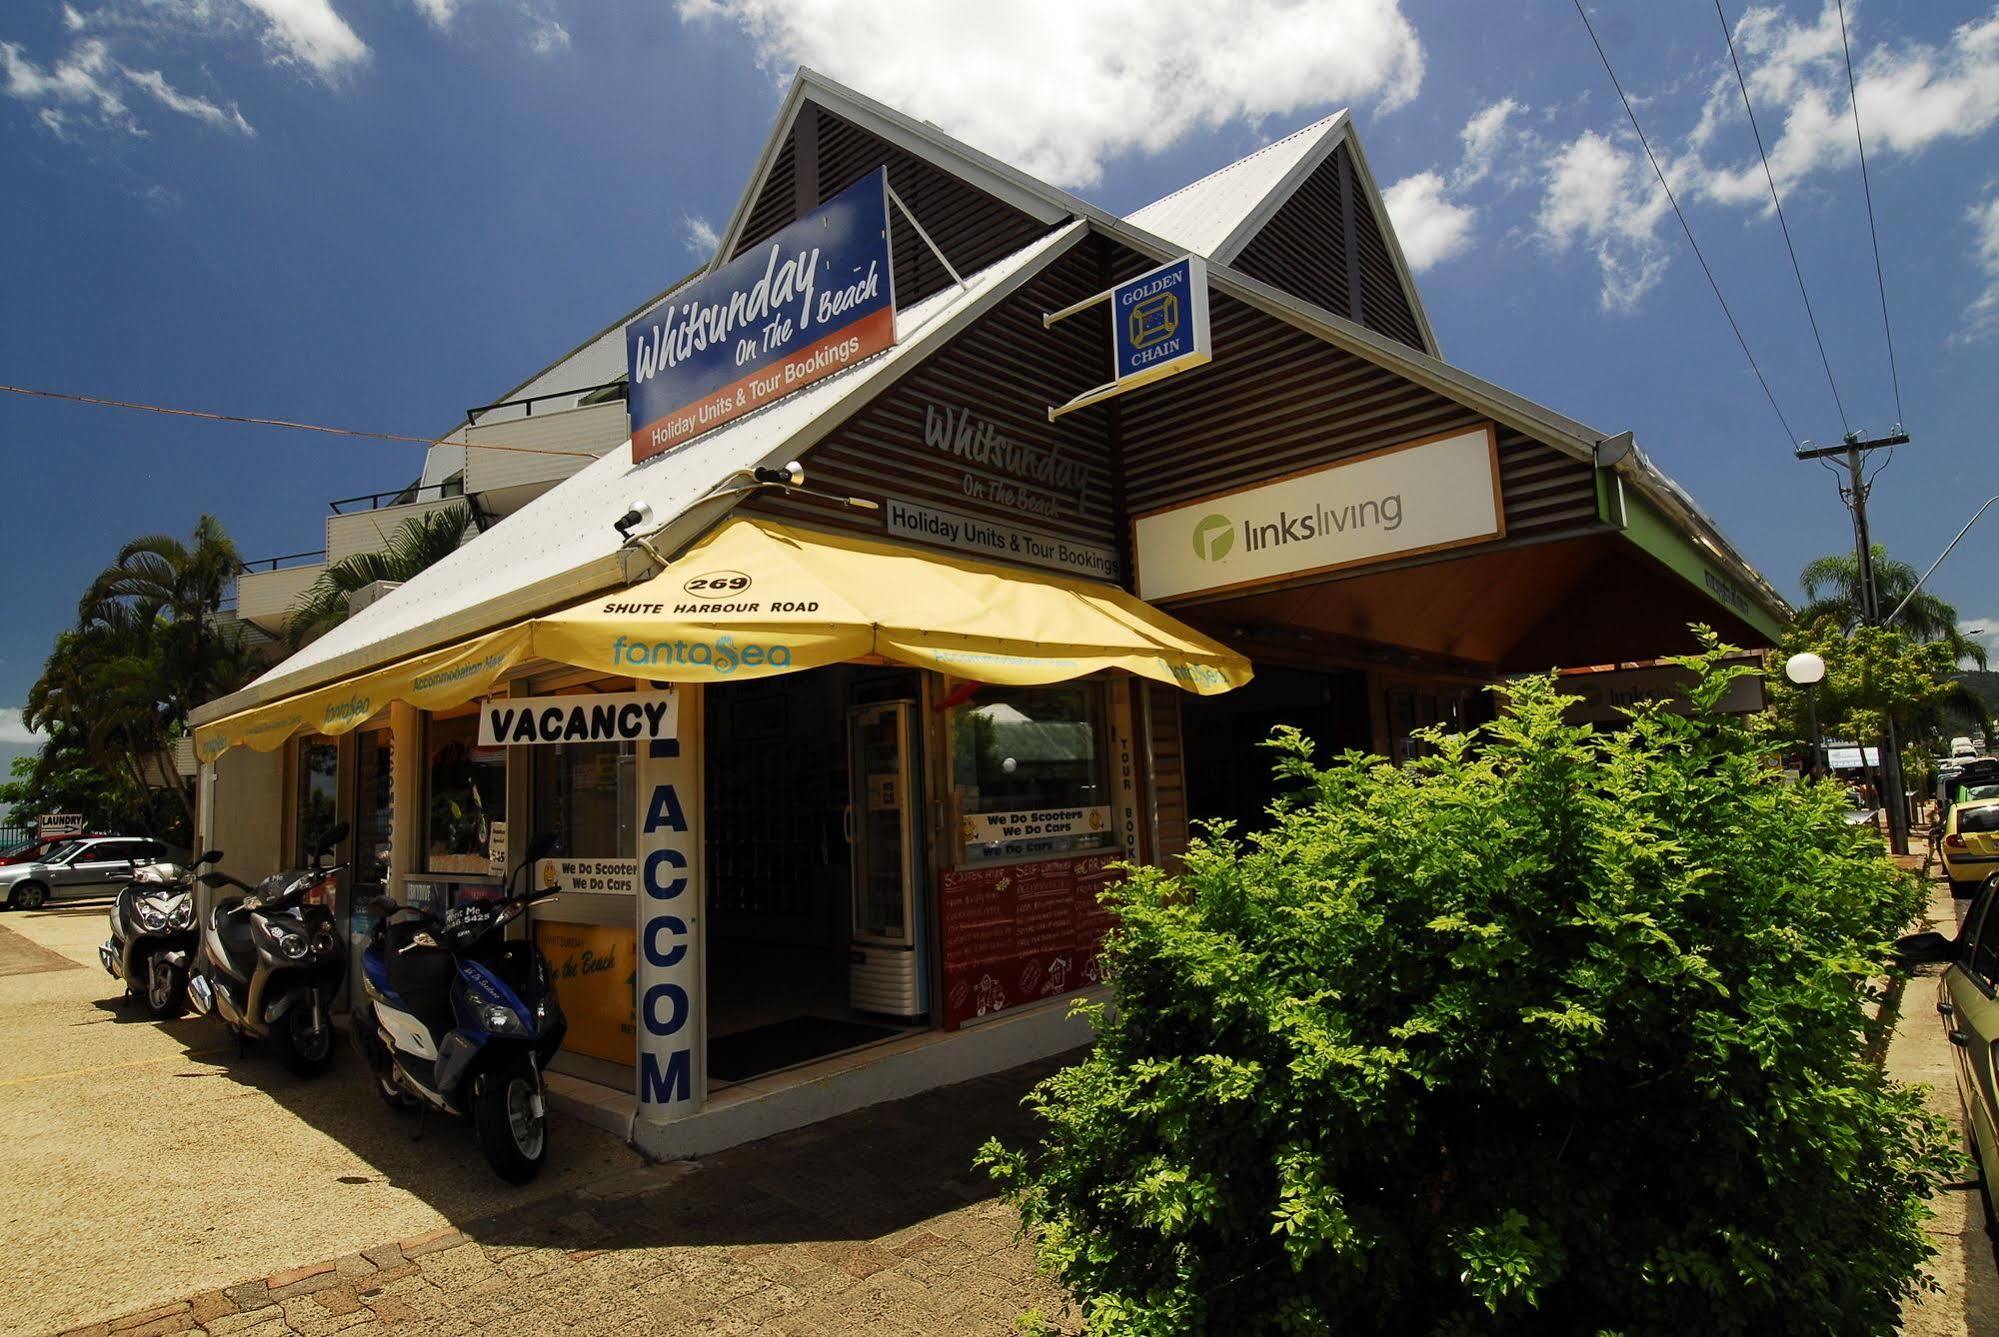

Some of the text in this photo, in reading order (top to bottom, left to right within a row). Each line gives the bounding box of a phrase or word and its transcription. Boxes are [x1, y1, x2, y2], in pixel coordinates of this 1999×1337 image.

[762, 313, 793, 352] The
[816, 260, 879, 324] Beach
[1122, 270, 1183, 305] GOLDEN
[636, 244, 820, 384] Whitsunday
[1131, 338, 1180, 366] CHAIN
[651, 335, 860, 447] Holiday Units & Tour Bookings
[924, 404, 1089, 514] Whitsunday
[963, 473, 1060, 519] On The Beach
[892, 506, 1119, 576] Holiday Units & Tour Bookings
[1245, 493, 1403, 552] linksliving
[688, 575, 749, 592] 269
[603, 601, 820, 614] SHUTE HARBOUR ROAD
[491, 701, 668, 742] VACANCY
[1121, 739, 1131, 790] TOUR
[42, 815, 82, 826] LAUNDRY
[987, 810, 1083, 825] We Do Scooters
[1002, 823, 1071, 837] We Do Cars
[562, 863, 578, 876] We
[580, 863, 593, 875] Do
[573, 877, 632, 891] We Do Cars
[466, 906, 481, 916] Me
[641, 784, 691, 1104] ACCOM
